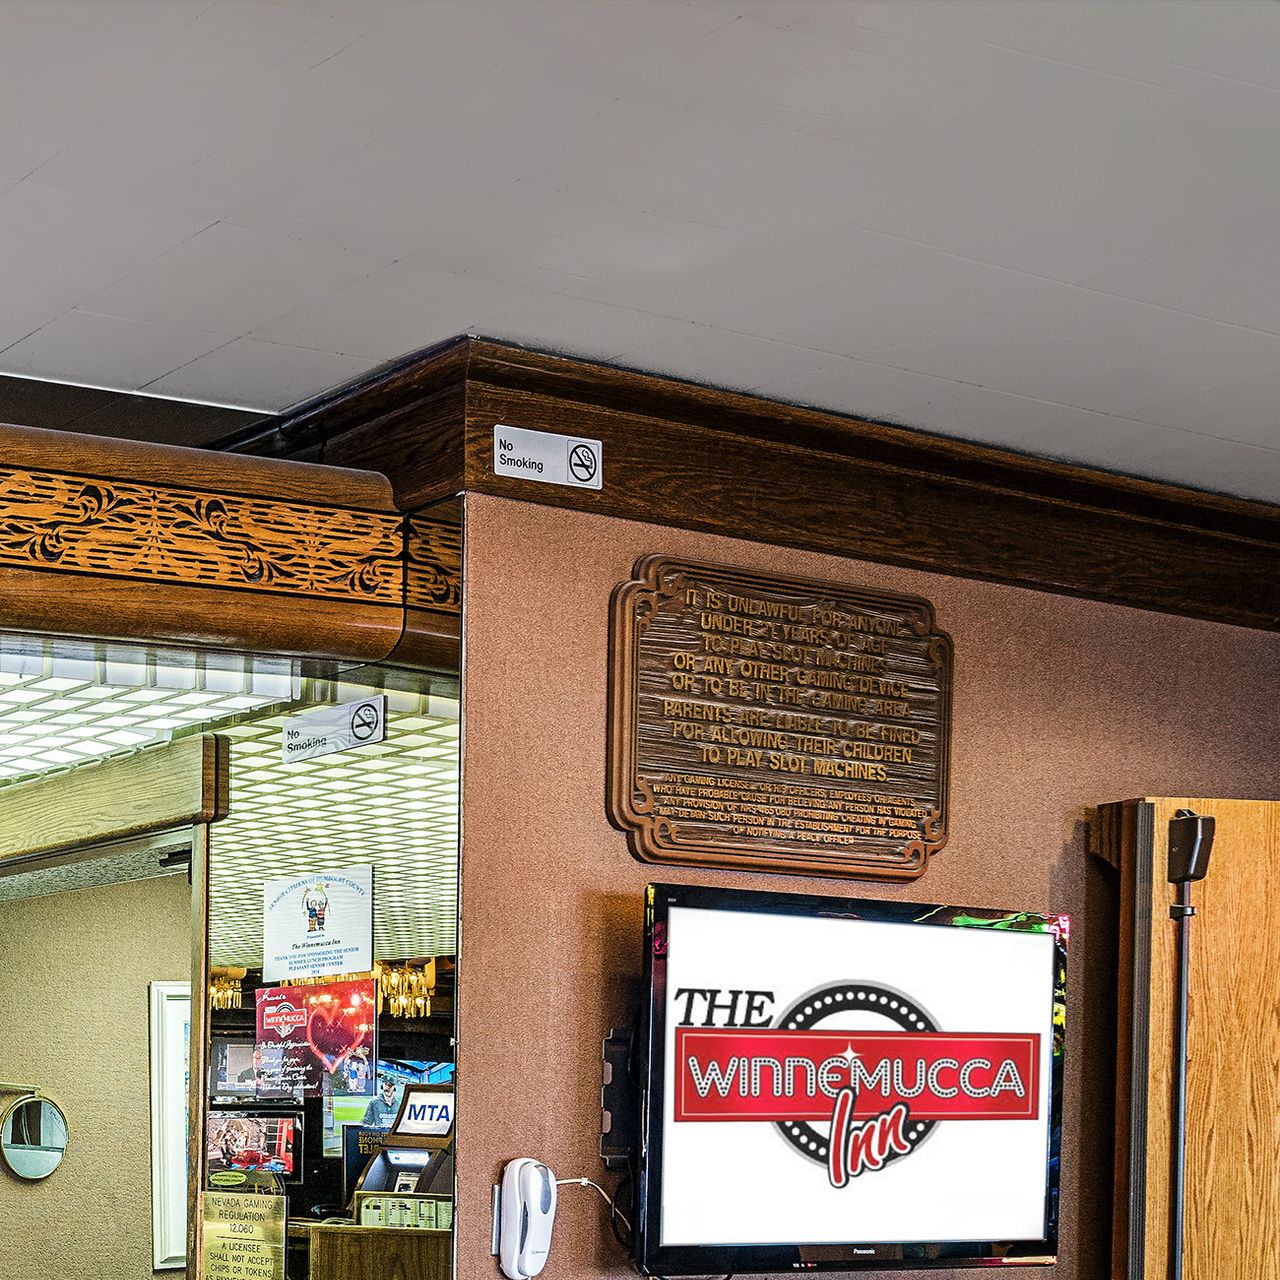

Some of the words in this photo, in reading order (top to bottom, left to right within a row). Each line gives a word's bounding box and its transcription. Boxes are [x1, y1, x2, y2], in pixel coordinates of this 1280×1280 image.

[500, 439, 513, 451] No
[500, 454, 543, 473] Smoking
[707, 592, 720, 609] IS
[728, 596, 806, 621] UNLAWFUL
[812, 608, 841, 627] FOR
[848, 616, 903, 636] ANYONE
[701, 612, 753, 635] UNDER
[783, 625, 829, 645] YEARS
[702, 633, 722, 653] TO
[730, 638, 766, 658] PLAY
[772, 641, 811, 661] SLOT
[673, 652, 696, 670] OR
[703, 656, 733, 675] ANY
[740, 660, 791, 682] OTHER
[797, 668, 855, 691] GAMING
[860, 678, 911, 698] DEVICE
[672, 672, 695, 690] OR
[704, 676, 722, 695] TO
[729, 680, 748, 698] BE
[756, 683, 772, 701] IN
[778, 685, 807, 704] THE
[811, 692, 870, 715] GAMING
[876, 699, 911, 718] AREA
[287, 730, 300, 741] No
[664, 700, 732, 723] PARENTS
[740, 709, 769, 727] ARE
[775, 712, 826, 734] LIABLE
[833, 719, 849, 736] TO
[856, 722, 876, 740] BE
[881, 724, 921, 745] FINED
[287, 737, 327, 753] Smoking
[672, 720, 704, 739] FOR
[712, 725, 788, 750] ALLOWING
[796, 736, 836, 755] THEIR
[842, 741, 913, 764] CHILDREN
[702, 745, 721, 763] TO
[727, 748, 763, 768] PLAY
[769, 753, 806, 774] SLOT
[653, 784, 673, 793] WHO
[676, 786, 696, 796] HAVE
[698, 788, 739, 800] PROBABLE
[741, 793, 767, 804] CAUSE
[769, 795, 785, 805] FOR
[789, 797, 825, 809] BELIEVING
[828, 801, 842, 810] ANY
[846, 803, 874, 814] PERSON
[877, 806, 891, 815] HAS
[894, 808, 927, 819] VIOLATED
[683, 776, 715, 786] GAMING
[760, 784, 771, 792] OR
[773, 785, 788, 793] HIS
[829, 790, 871, 802] EMPLOYEES
[874, 794, 885, 803] OR
[664, 797, 680, 805] ANY
[683, 798, 724, 810] PROVISION
[727, 802, 737, 810] OF
[794, 808, 839, 820] PROHIBITING
[841, 812, 877, 824] CHEATING
[708, 811, 730, 821] SUCH
[733, 814, 765, 825] PERSON
[766, 817, 775, 825] IN
[778, 818, 793, 827] THE
[795, 820, 852, 833] ESTABLISHMENT
[855, 826, 870, 835] FOR
[873, 828, 887, 836] THE
[889, 830, 922, 840] PURPOSE
[745, 827, 786, 839] NOTIFYING
[796, 833, 821, 842] PEACE
[292, 943, 301, 951] The
[301, 939, 332, 949] Winnemucca
[674, 988, 775, 1028] THE
[687, 1055, 1027, 1098] WINNEMUCCA
[828, 1086, 914, 1189] Inn
[211, 1197, 240, 1207] NEVADA
[243, 1199, 273, 1210] GAMING
[218, 1209, 266, 1222] REGULATION
[209, 1252, 229, 1262] SHALL
[232, 1254, 245, 1263] NOT
[248, 1256, 274, 1266] ACCEPT
[229, 1242, 261, 1253] LICENSEE
[210, 1263, 230, 1273] CHIPS
[232, 1266, 242, 1274] OR
[245, 1267, 272, 1278] TOKENS
